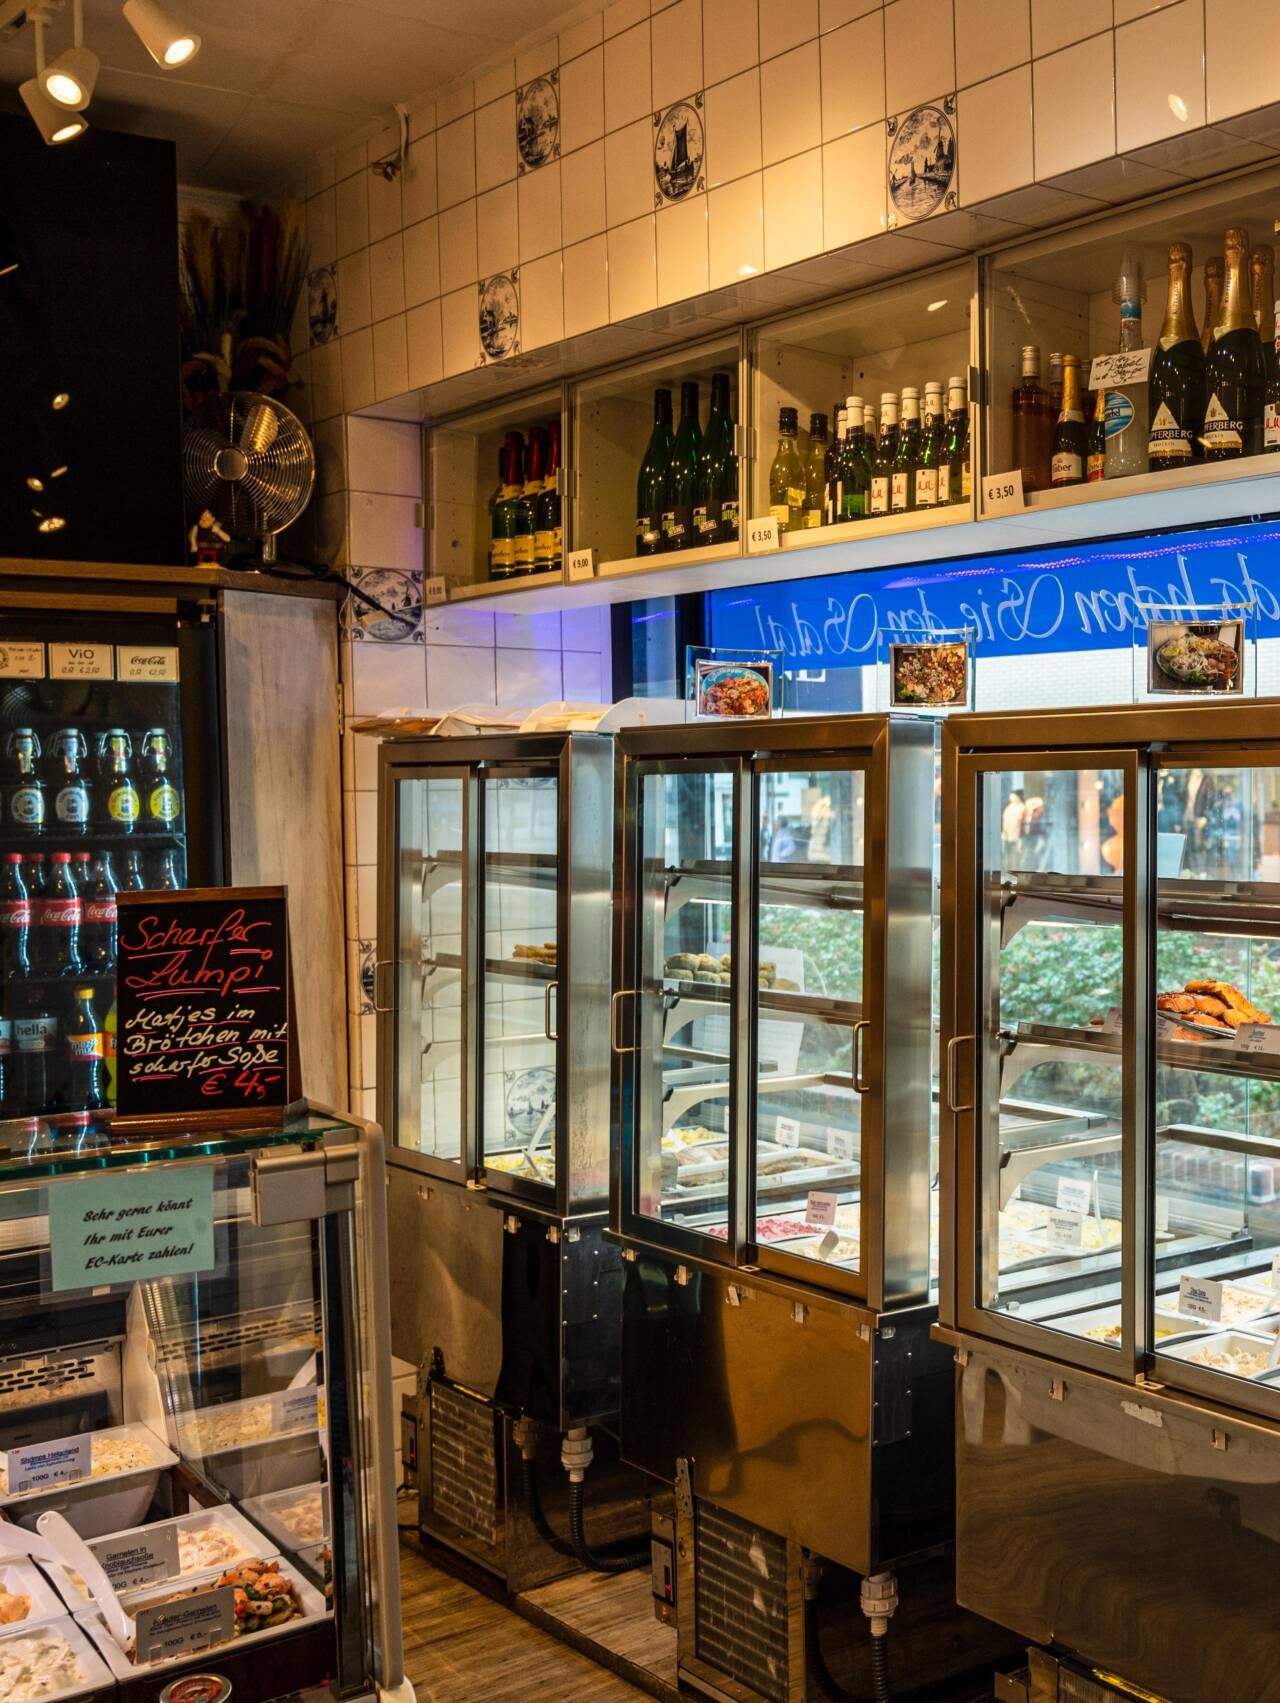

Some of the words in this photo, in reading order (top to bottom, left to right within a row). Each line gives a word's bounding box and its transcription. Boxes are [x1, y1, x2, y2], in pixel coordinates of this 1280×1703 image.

[988, 490, 995, 501] €
[995, 484, 1015, 500] 3,50
[751, 531, 757, 542] €
[757, 529, 772, 541] 3,50
[577, 557, 589, 568] 9,00
[121, 908, 272, 962] Scharfer
[125, 950, 273, 997] Lumpi
[16, 1022, 48, 1036] hella
[125, 1005, 217, 1034] Matjes
[227, 1003, 257, 1021] im
[124, 1029, 241, 1054] Brötchen
[248, 1022, 288, 1043] mit
[219, 1044, 279, 1073] Soße
[200, 1073, 226, 1095] €
[82, 1207, 115, 1223] Sehr
[116, 1205, 153, 1223] gerne
[156, 1197, 194, 1215] könnt
[82, 1230, 107, 1247] Ihr
[110, 1226, 134, 1242] mit
[137, 1224, 174, 1239] Eurer
[84, 1250, 144, 1271] EC-Karte
[148, 1242, 195, 1261] zahlen!
